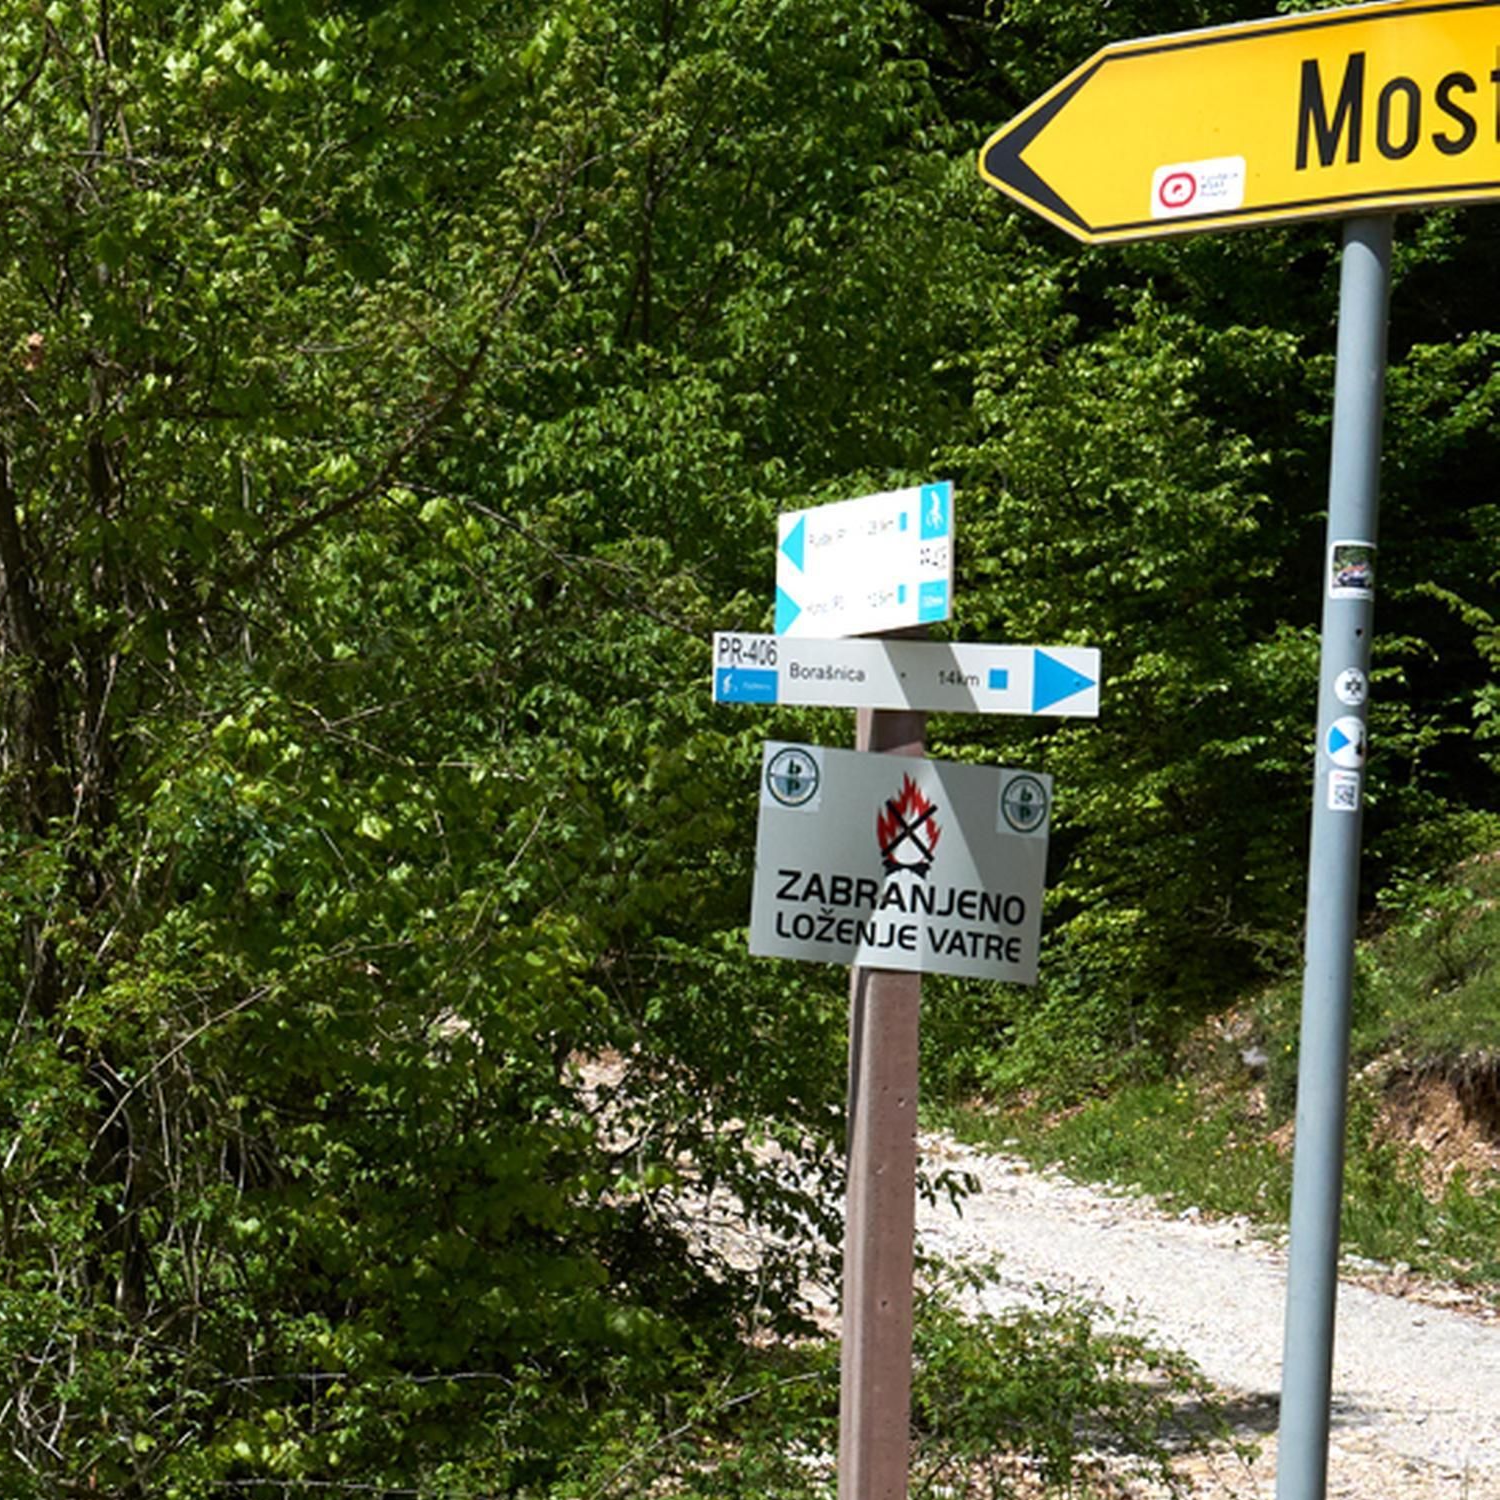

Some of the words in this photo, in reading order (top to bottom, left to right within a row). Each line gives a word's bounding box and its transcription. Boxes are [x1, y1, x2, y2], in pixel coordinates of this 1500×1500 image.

[1295, 46, 1500, 171] Mos
[718, 637, 777, 666] PR-406
[789, 661, 866, 683] Borašnica
[776, 870, 1026, 926] ZABRANJENO
[776, 908, 918, 949] LOŽENJE
[928, 926, 1022, 963] VATRE
